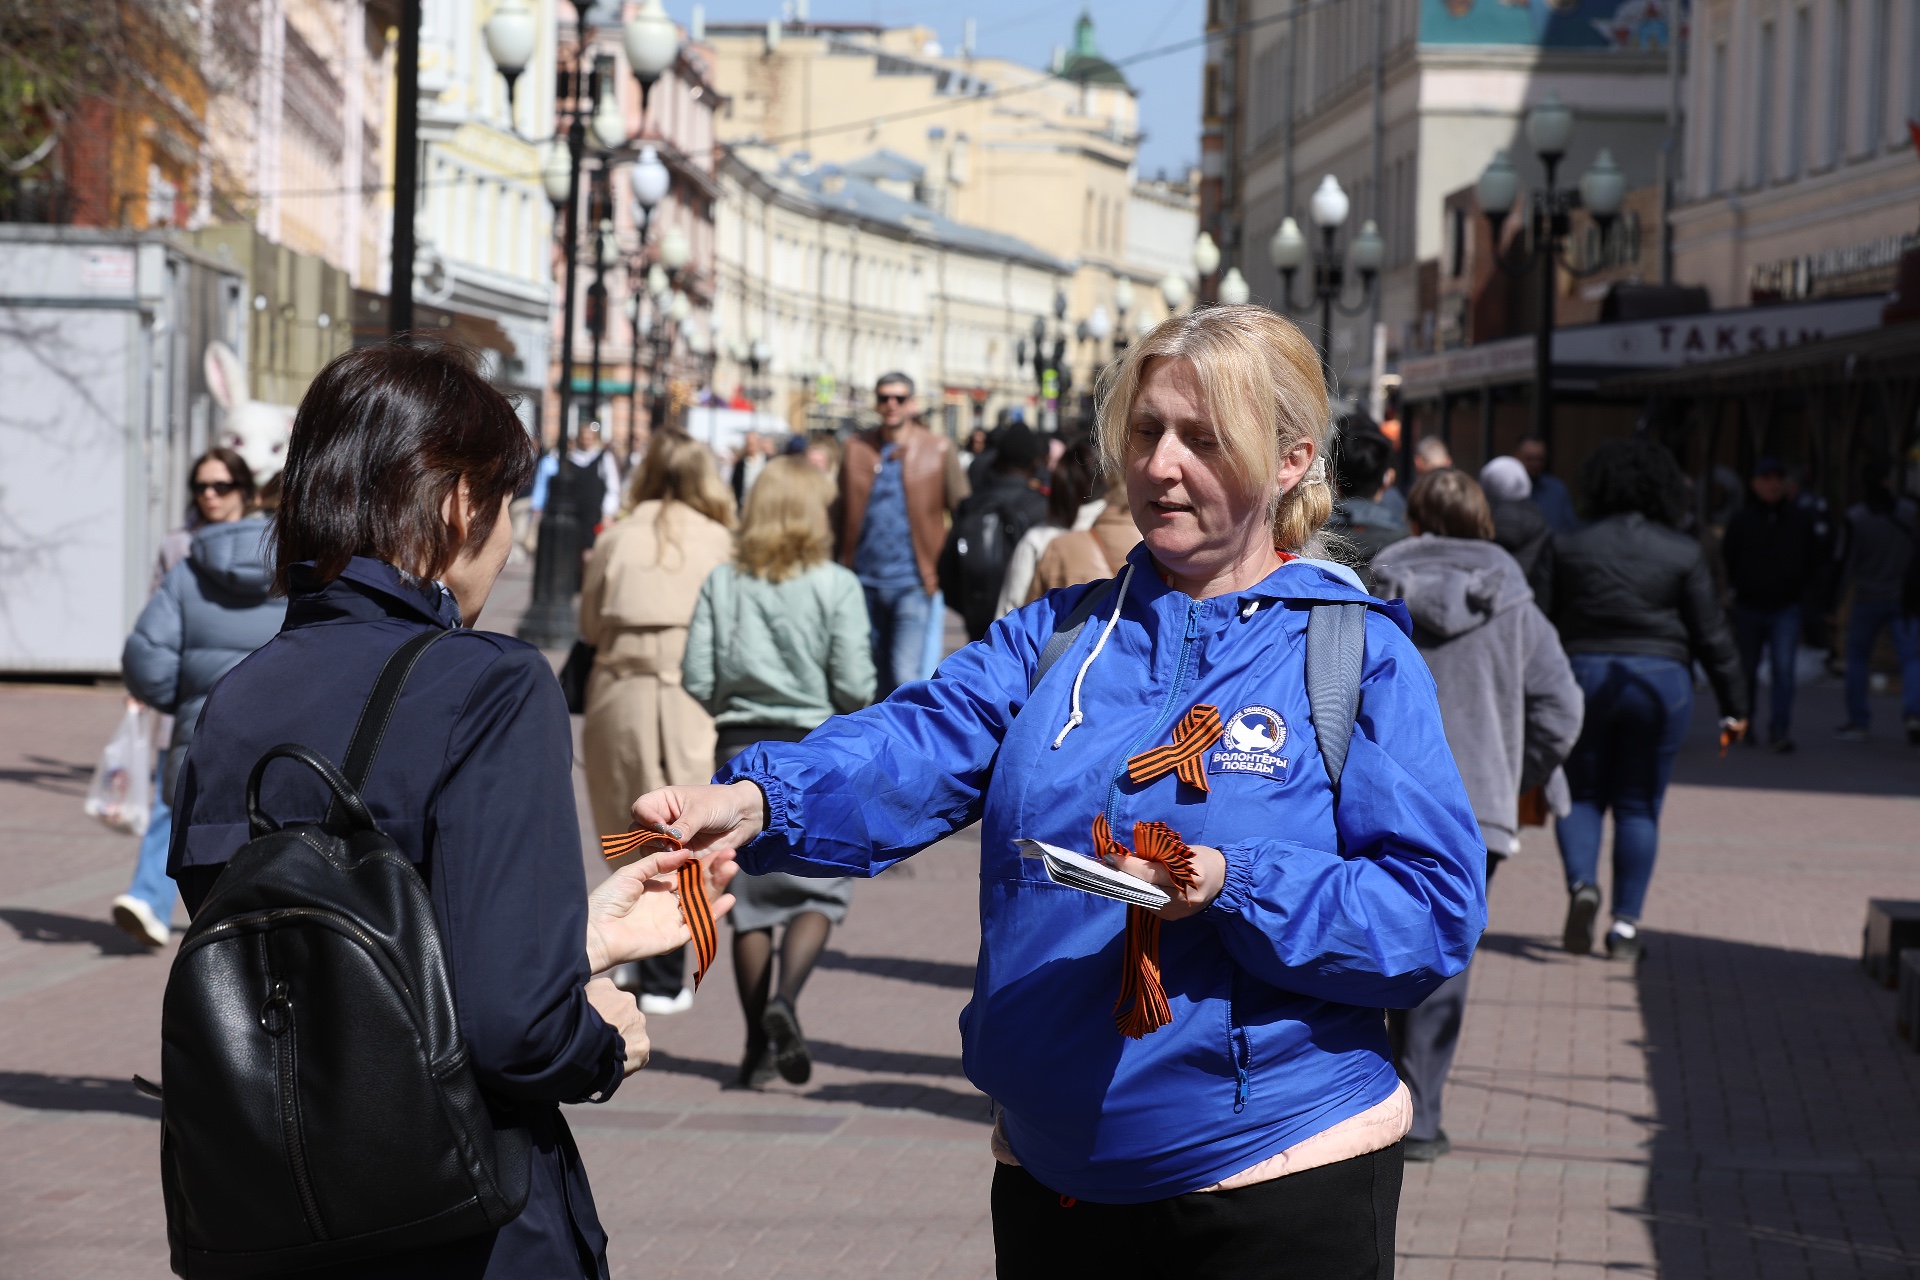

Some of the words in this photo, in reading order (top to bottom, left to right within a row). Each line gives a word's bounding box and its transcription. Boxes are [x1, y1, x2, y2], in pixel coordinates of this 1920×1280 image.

[1656, 323, 1825, 353] TAKSIM
[1213, 752, 1288, 768] ВОЛОНТЁРЫ
[1221, 761, 1274, 774] ПОБЕДЫ
